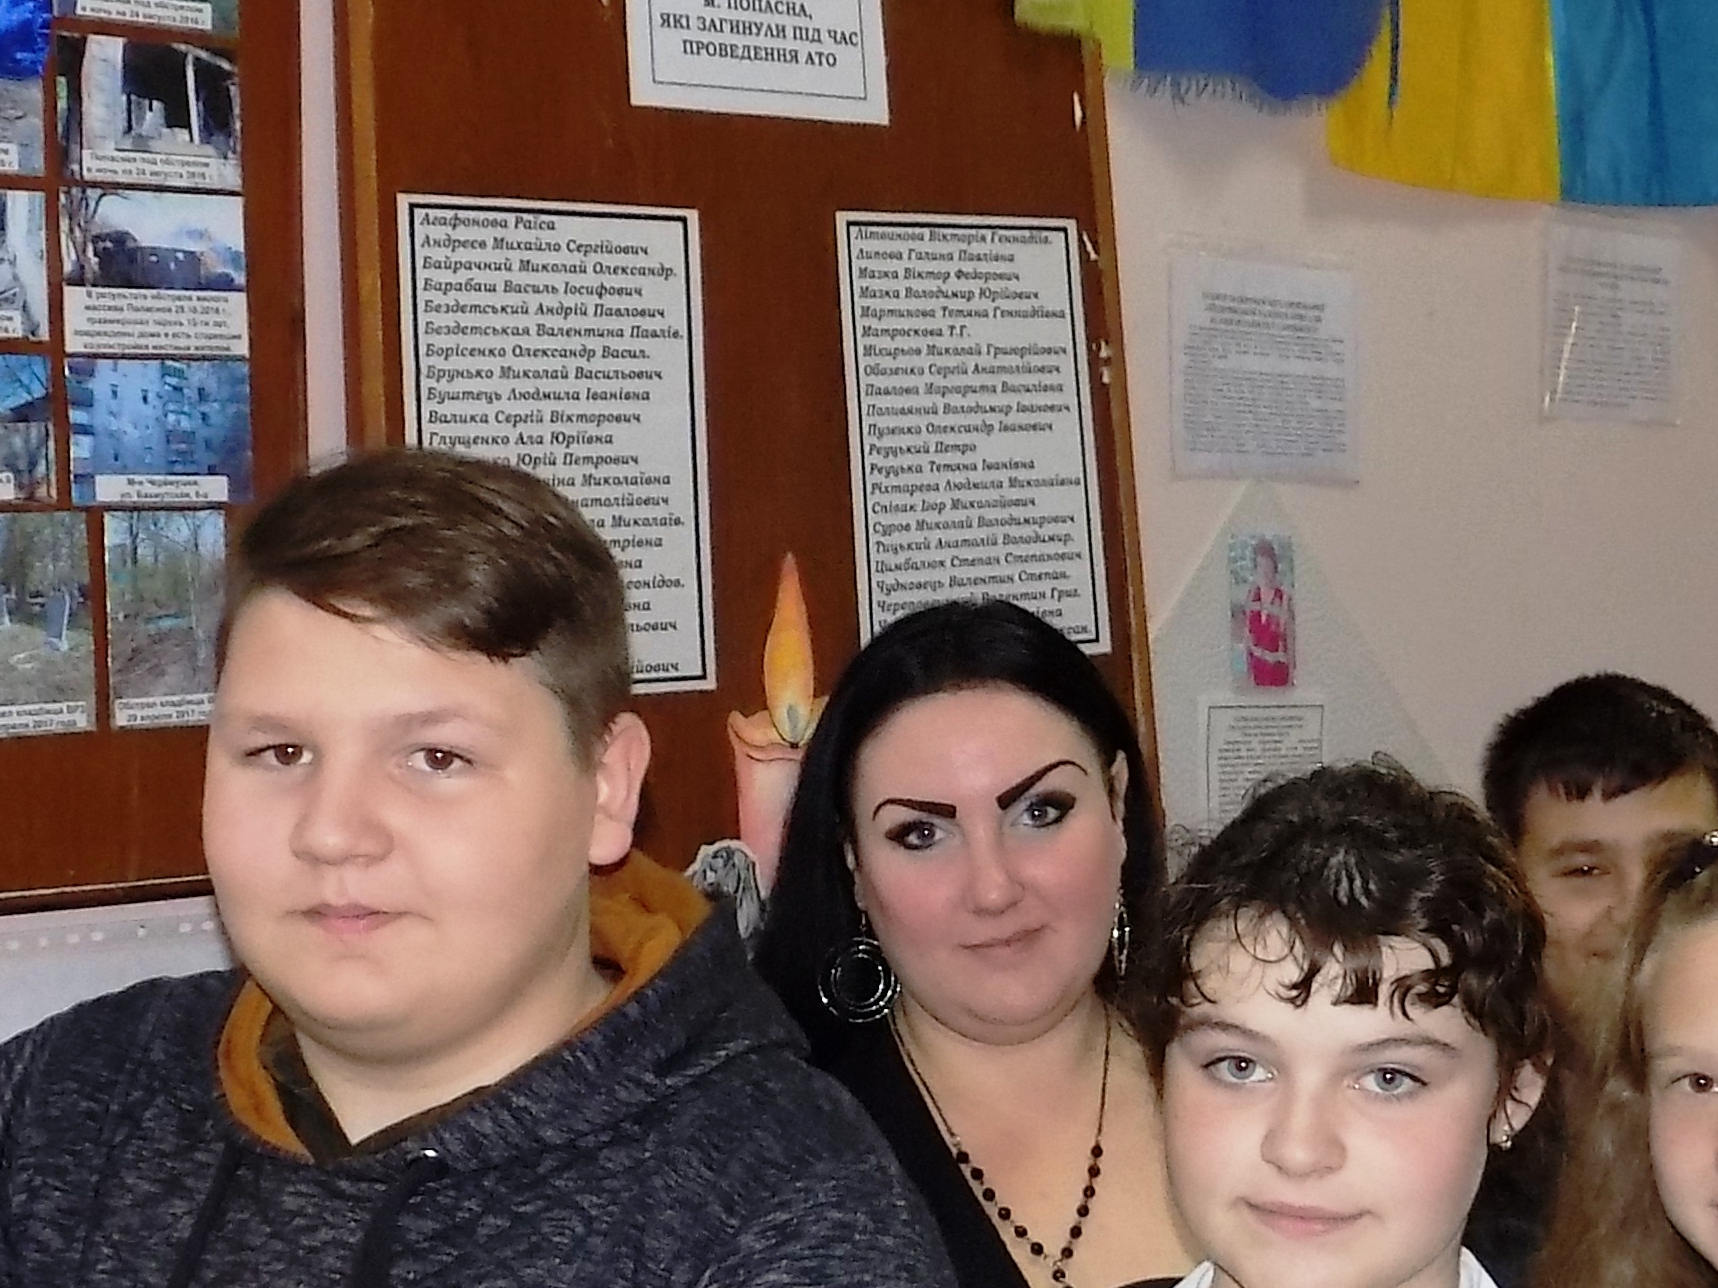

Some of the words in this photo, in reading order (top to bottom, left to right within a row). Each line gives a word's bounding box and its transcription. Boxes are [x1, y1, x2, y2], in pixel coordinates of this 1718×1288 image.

[659, 13, 692, 31] ЯКІ
[696, 15, 788, 41] ЗАГИНУЛИ
[792, 23, 824, 45] ПІД
[827, 27, 859, 48] ЧАС
[682, 38, 801, 66] ПРОВЕДЕННЯ
[804, 48, 838, 68] АТО
[514, 214, 556, 230] Раїса
[492, 236, 561, 252] Михайло
[566, 239, 649, 257] Сергійович
[422, 256, 513, 274] Байрачний
[519, 259, 588, 275] Миколай
[592, 262, 678, 280] Олександр.
[422, 278, 497, 294] Барабаш
[503, 280, 559, 295] Василь
[535, 302, 588, 320] Андрій
[593, 304, 666, 319] Павлович
[535, 324, 624, 338] Валентина
[425, 344, 506, 360] Борісенко
[512, 346, 596, 362] Олександр
[601, 346, 651, 360] Васил.
[499, 365, 569, 380] Миколай
[574, 366, 663, 381] Васильович
[507, 387, 581, 402] Людмила
[586, 388, 651, 402] Іванівна
[494, 410, 544, 427] Сергій
[550, 410, 641, 425] Вікторович
[428, 432, 510, 449] Глущенко
[550, 432, 614, 448] Юріївна
[516, 452, 557, 468] Юрій
[563, 452, 639, 468] Петрович
[581, 473, 671, 488] Миколаївна
